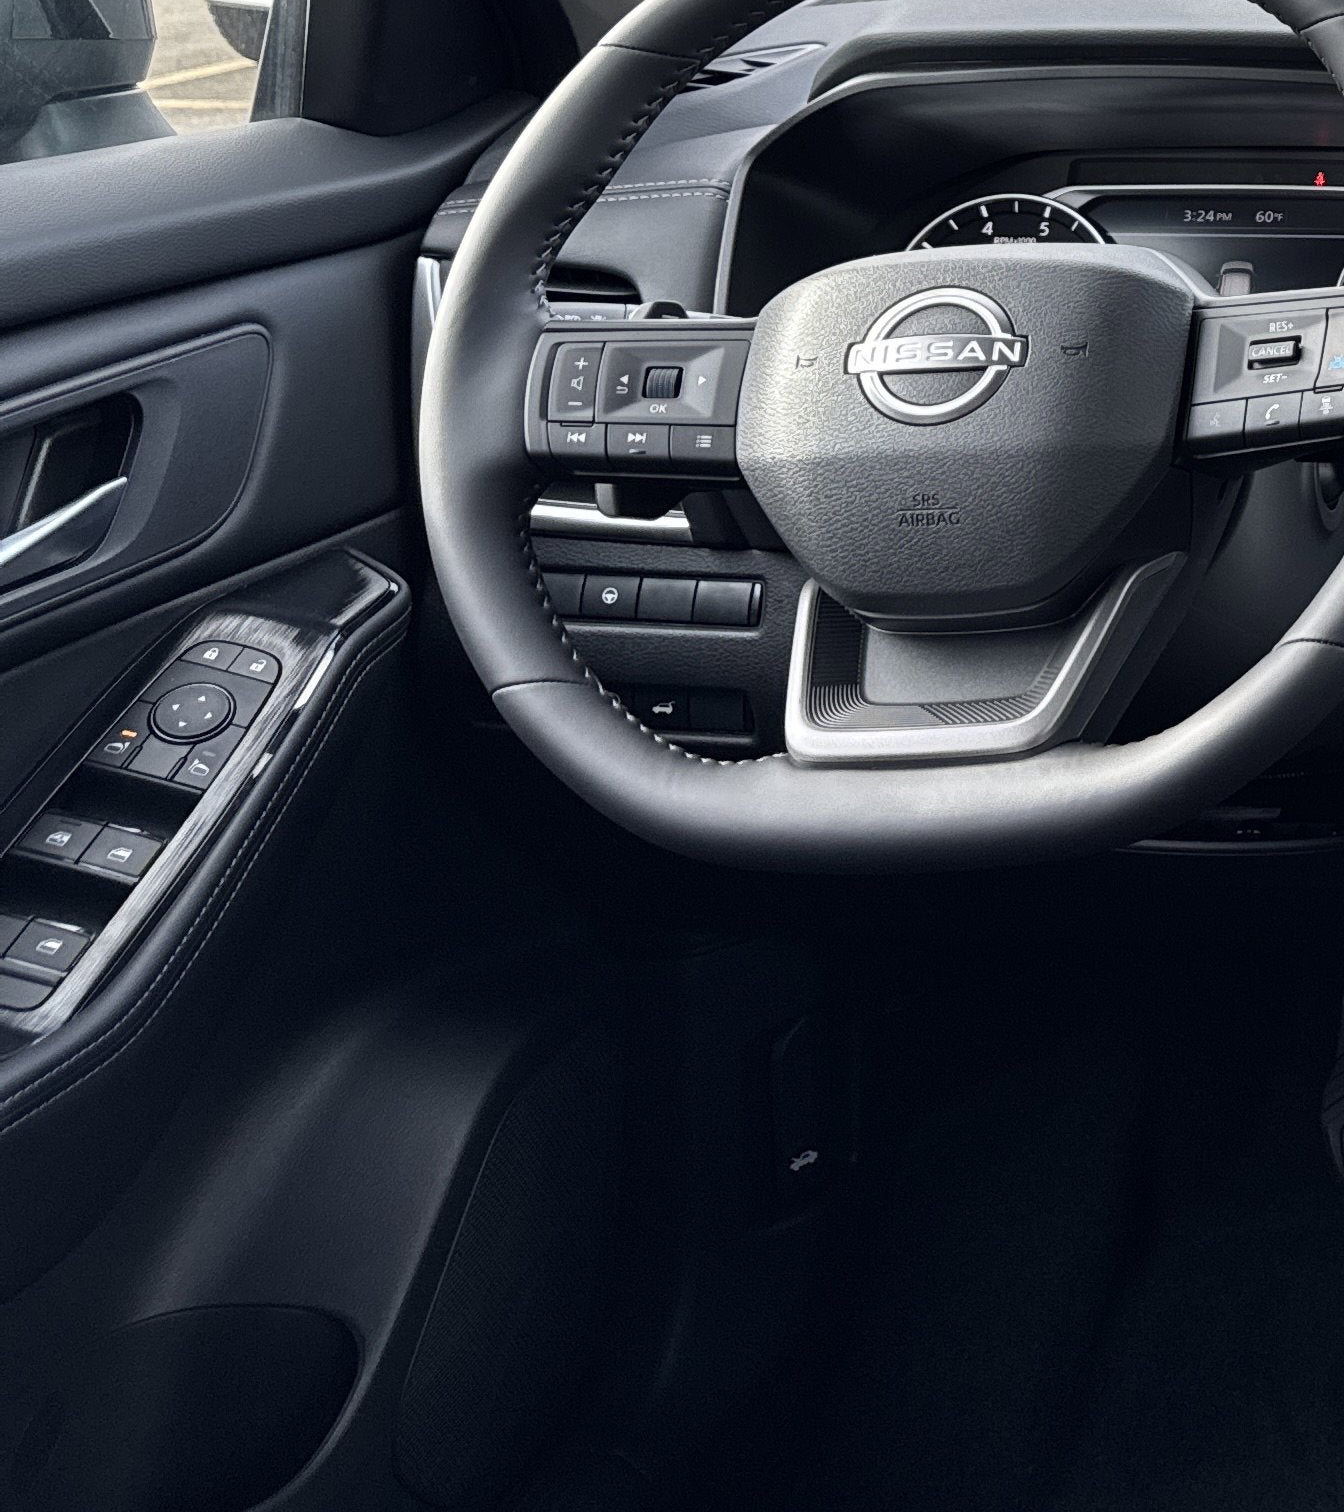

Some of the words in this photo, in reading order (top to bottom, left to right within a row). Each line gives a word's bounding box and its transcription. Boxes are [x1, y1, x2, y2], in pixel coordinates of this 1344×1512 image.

[1184, 210, 1214, 222] 3:24
[1216, 212, 1232, 221] PM
[1256, 210, 1284, 223] 60°F
[981, 221, 993, 235] 4
[1039, 222, 1049, 236] 5
[1269, 321, 1293, 332] RES+
[854, 340, 1021, 367] NISSAN
[1252, 346, 1290, 357] CANCEL
[650, 404, 667, 413] OK
[912, 493, 940, 507] SRS
[898, 511, 960, 527] AIRBAG
